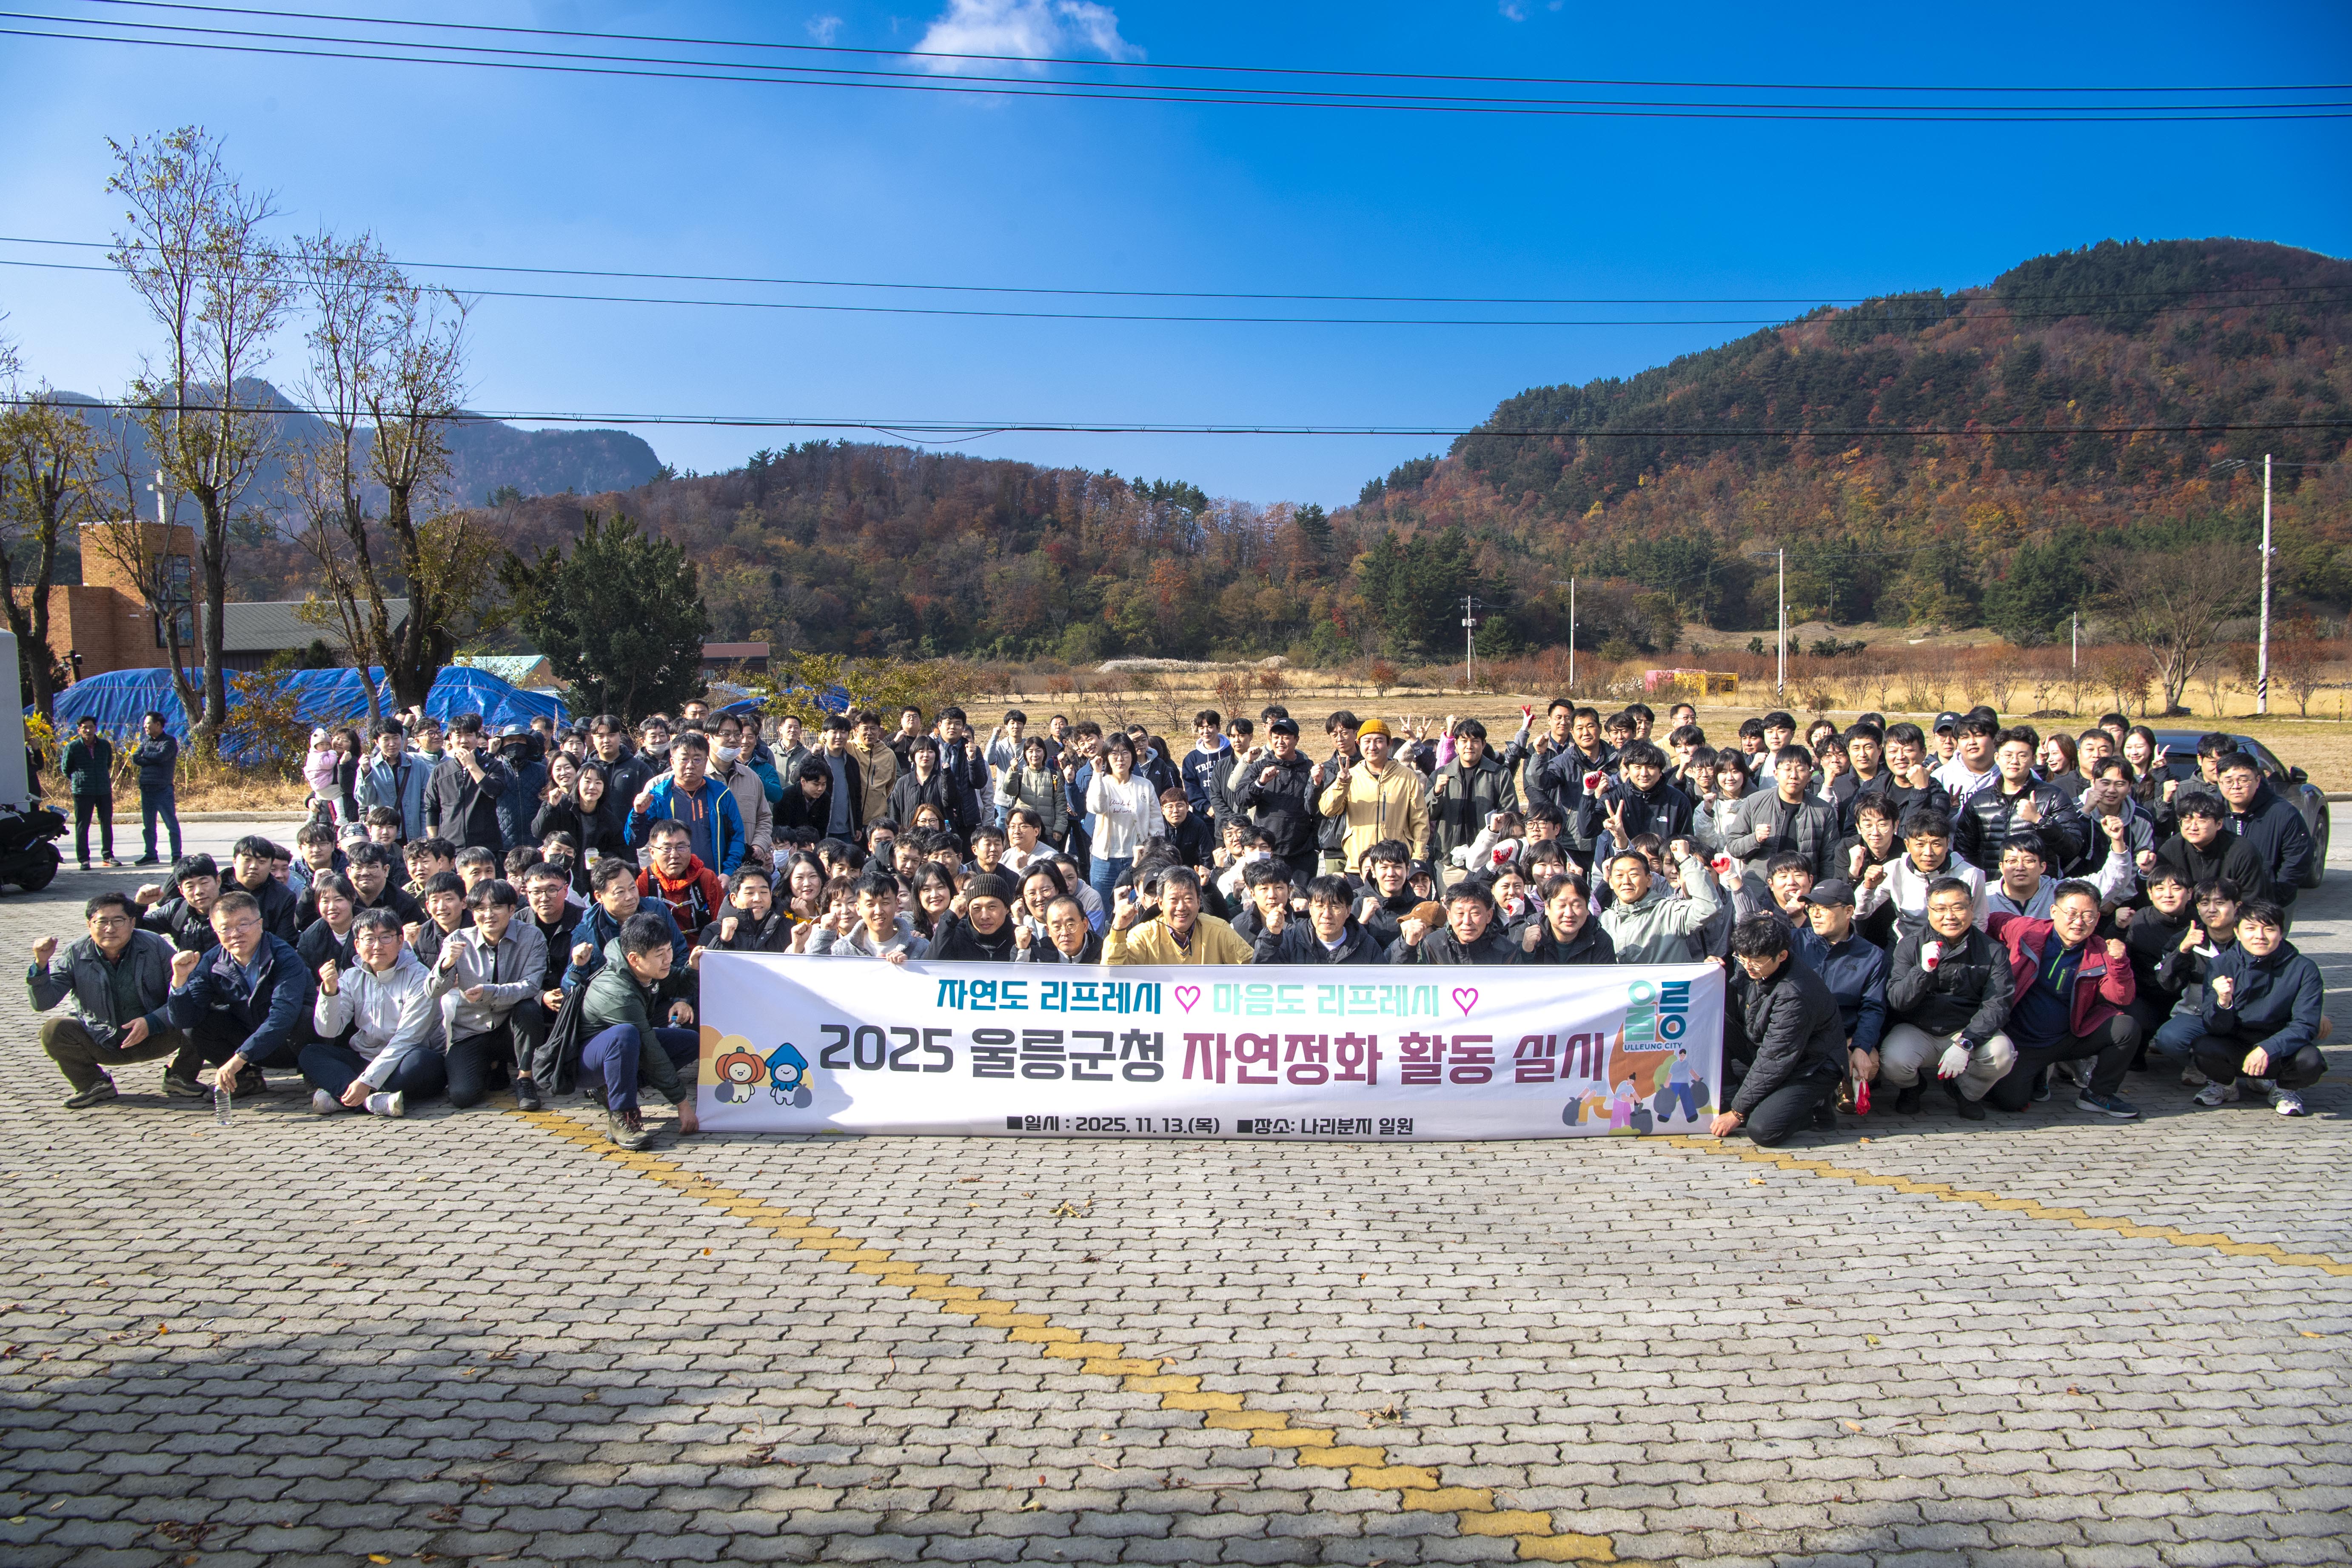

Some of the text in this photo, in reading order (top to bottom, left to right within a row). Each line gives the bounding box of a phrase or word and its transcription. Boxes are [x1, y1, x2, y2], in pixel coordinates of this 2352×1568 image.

[937, 980, 1439, 1017] 자연도 리프레시 마음도 리프레시
[820, 1024, 1604, 1085] 2025 울릉군청 자연정화 활동 실시
[1625, 1043, 1662, 1051] ULLEUNG
[1076, 1117, 1130, 1132] 2025.
[1136, 1118, 1157, 1133] 11.
[1162, 1118, 1220, 1134] 13.(목)
[1301, 1118, 1372, 1135] 나리분지
[1379, 1118, 1413, 1135] 일원
